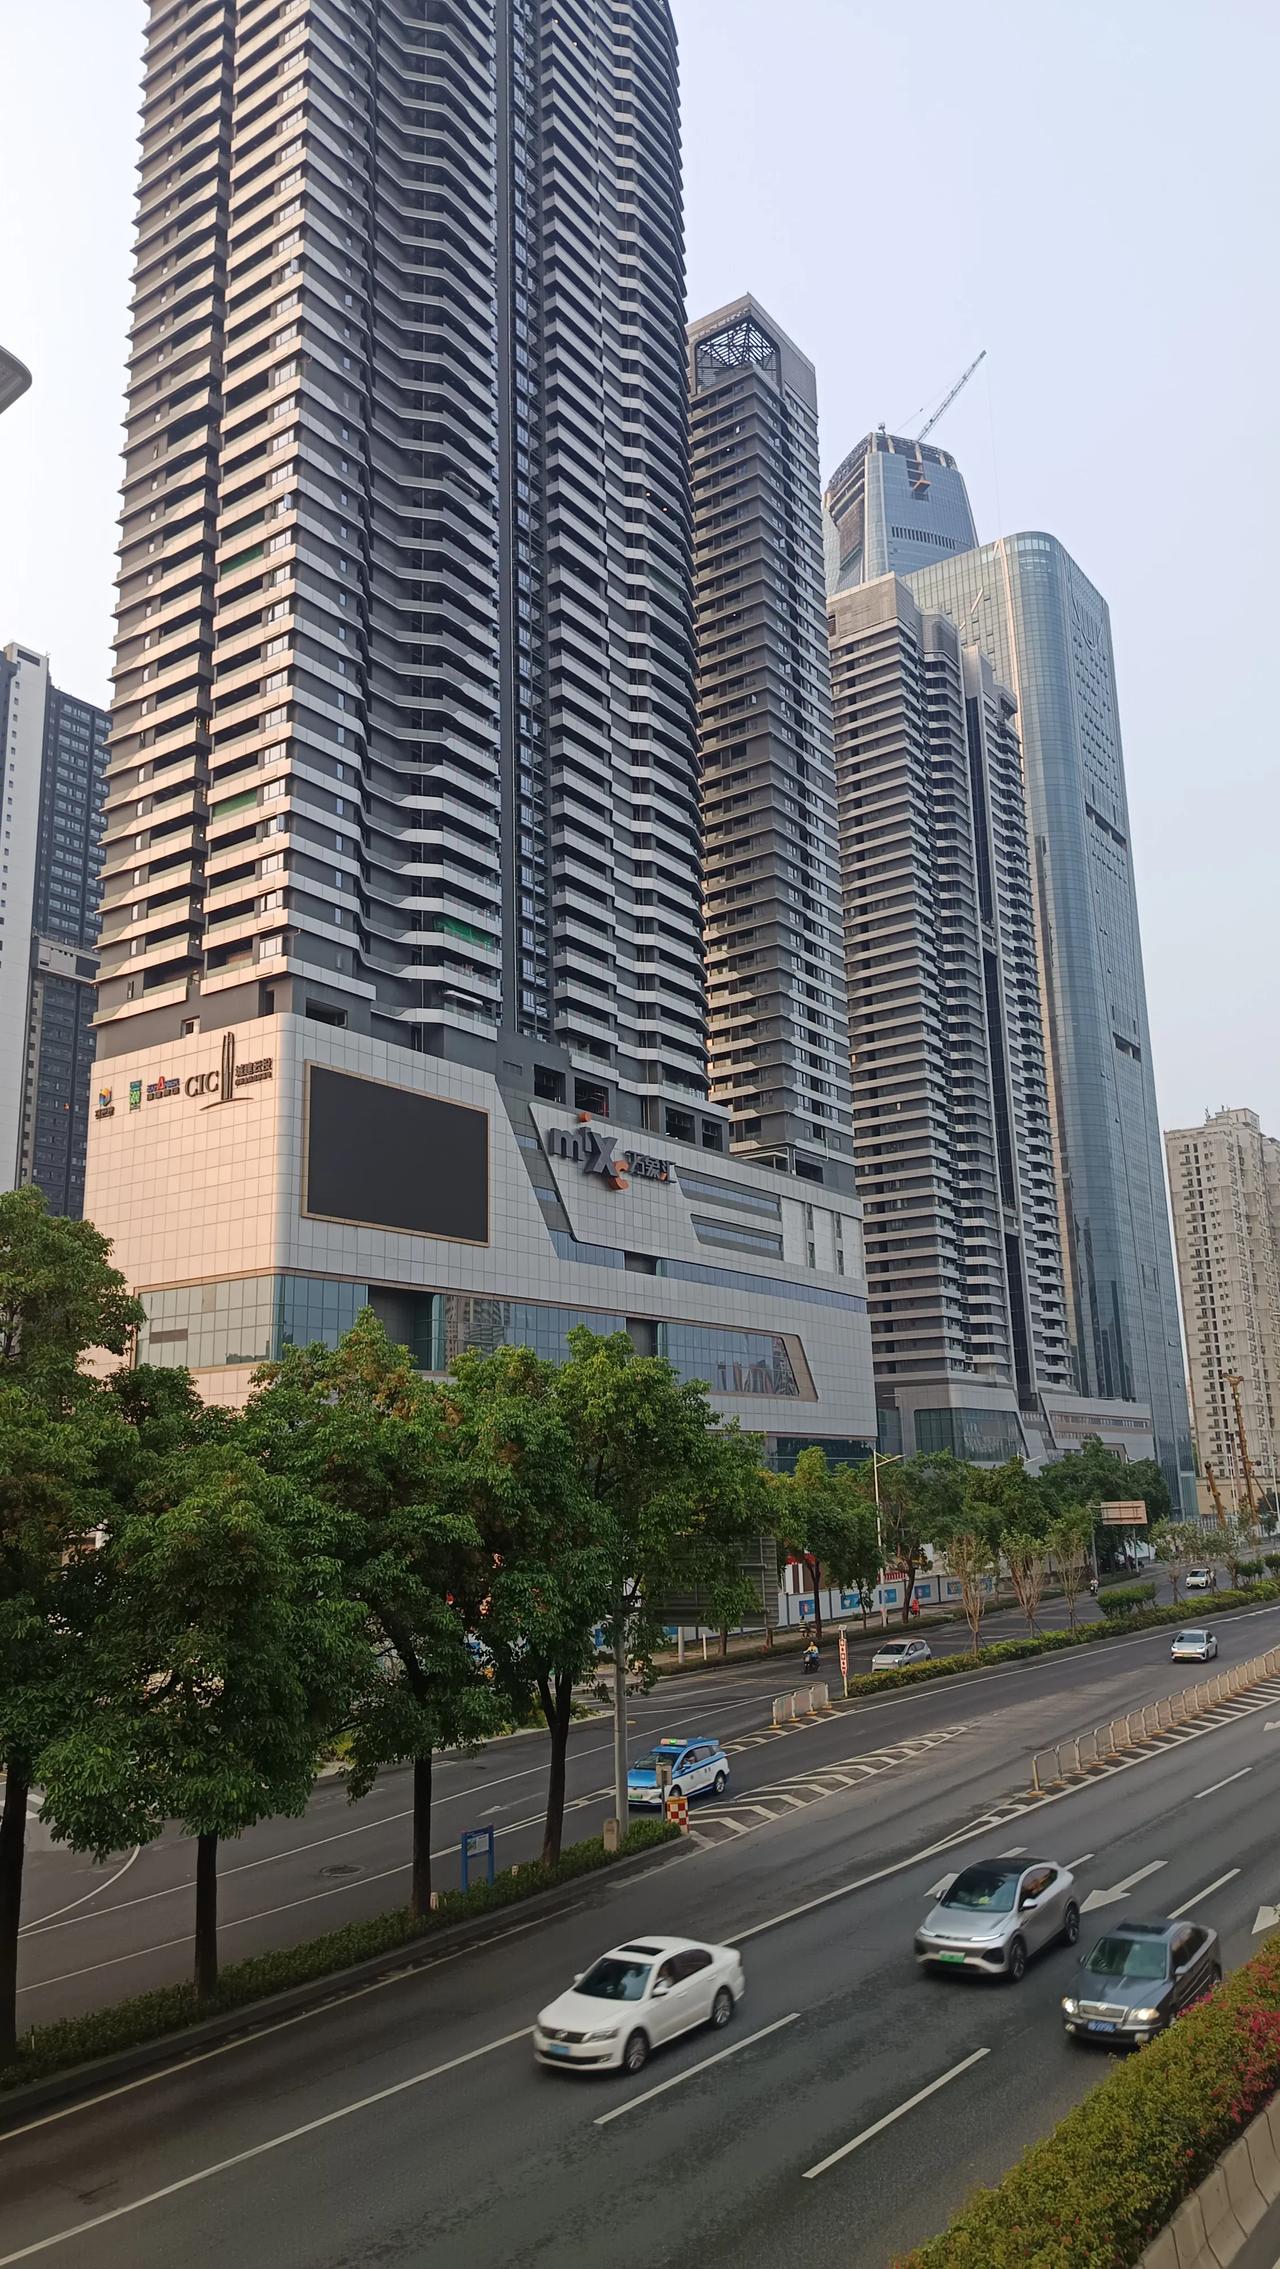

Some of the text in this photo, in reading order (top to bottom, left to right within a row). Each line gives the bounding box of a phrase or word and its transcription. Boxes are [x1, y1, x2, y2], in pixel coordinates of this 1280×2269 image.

[185, 1070, 219, 1098] CIC
[624, 1150, 677, 1184] 万象汇
